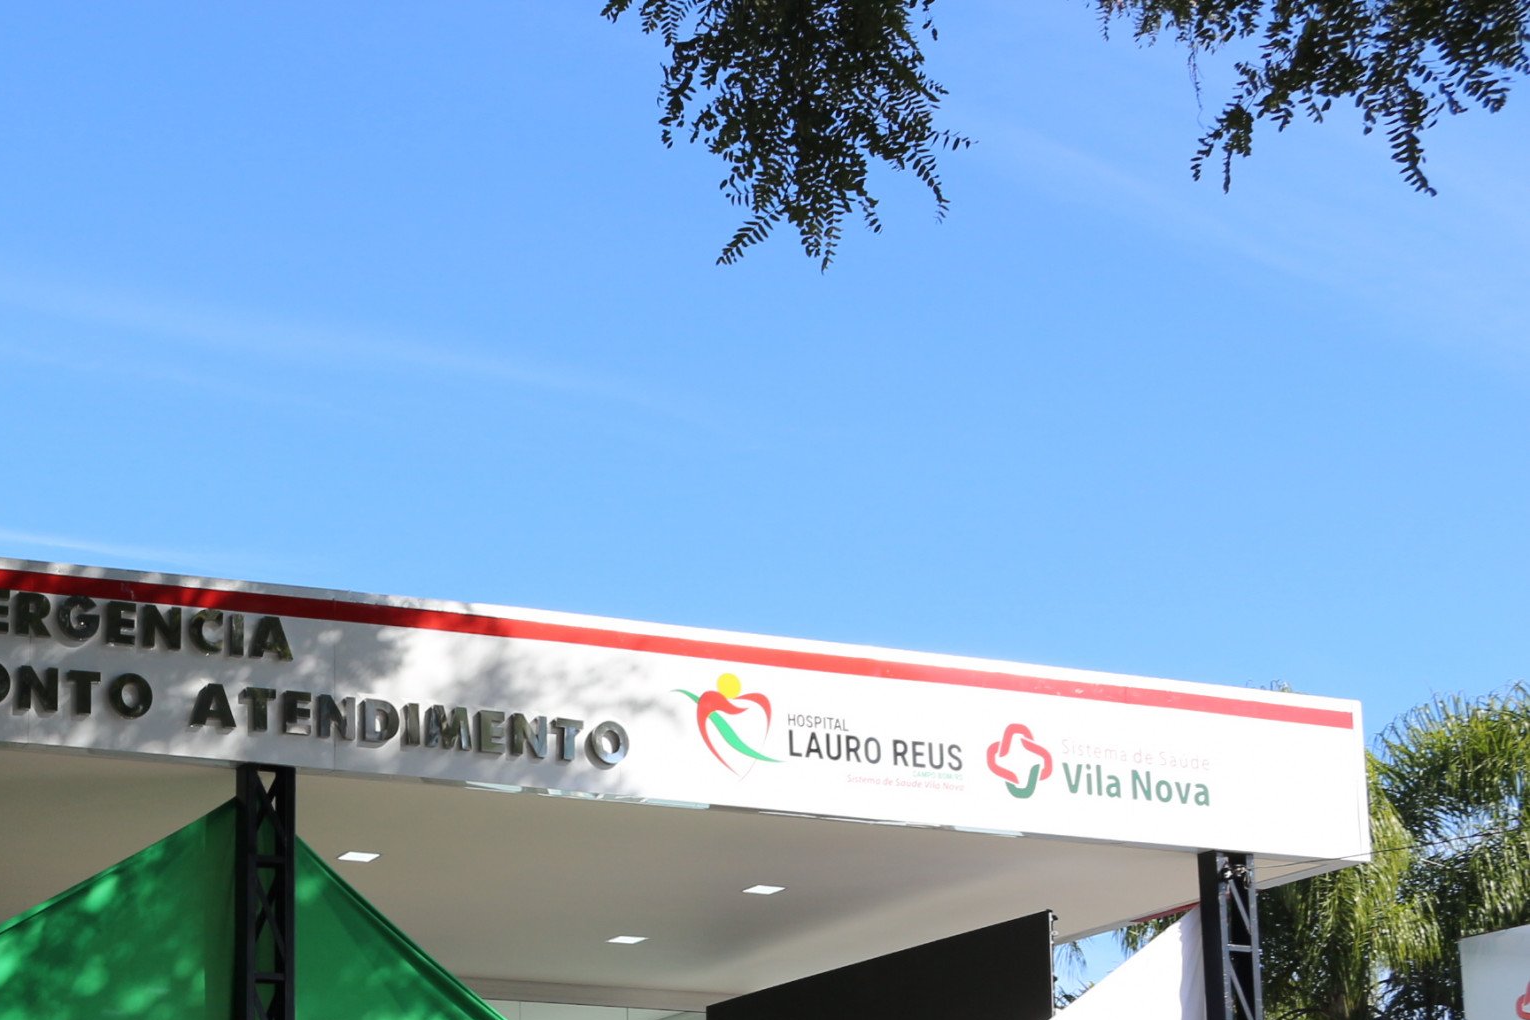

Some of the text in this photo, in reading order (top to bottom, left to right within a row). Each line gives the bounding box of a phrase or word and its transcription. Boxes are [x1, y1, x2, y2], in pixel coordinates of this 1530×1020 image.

[188, 682, 630, 766] ATENDIMENTO
[787, 713, 849, 732] HOSPITAL
[788, 729, 963, 771] LAURO REUS
[1061, 738, 1127, 762] Sistema
[1133, 747, 1154, 765] de
[883, 777, 894, 786] de
[924, 780, 941, 790] Vila
[1061, 762, 1211, 807] Vila Nova
